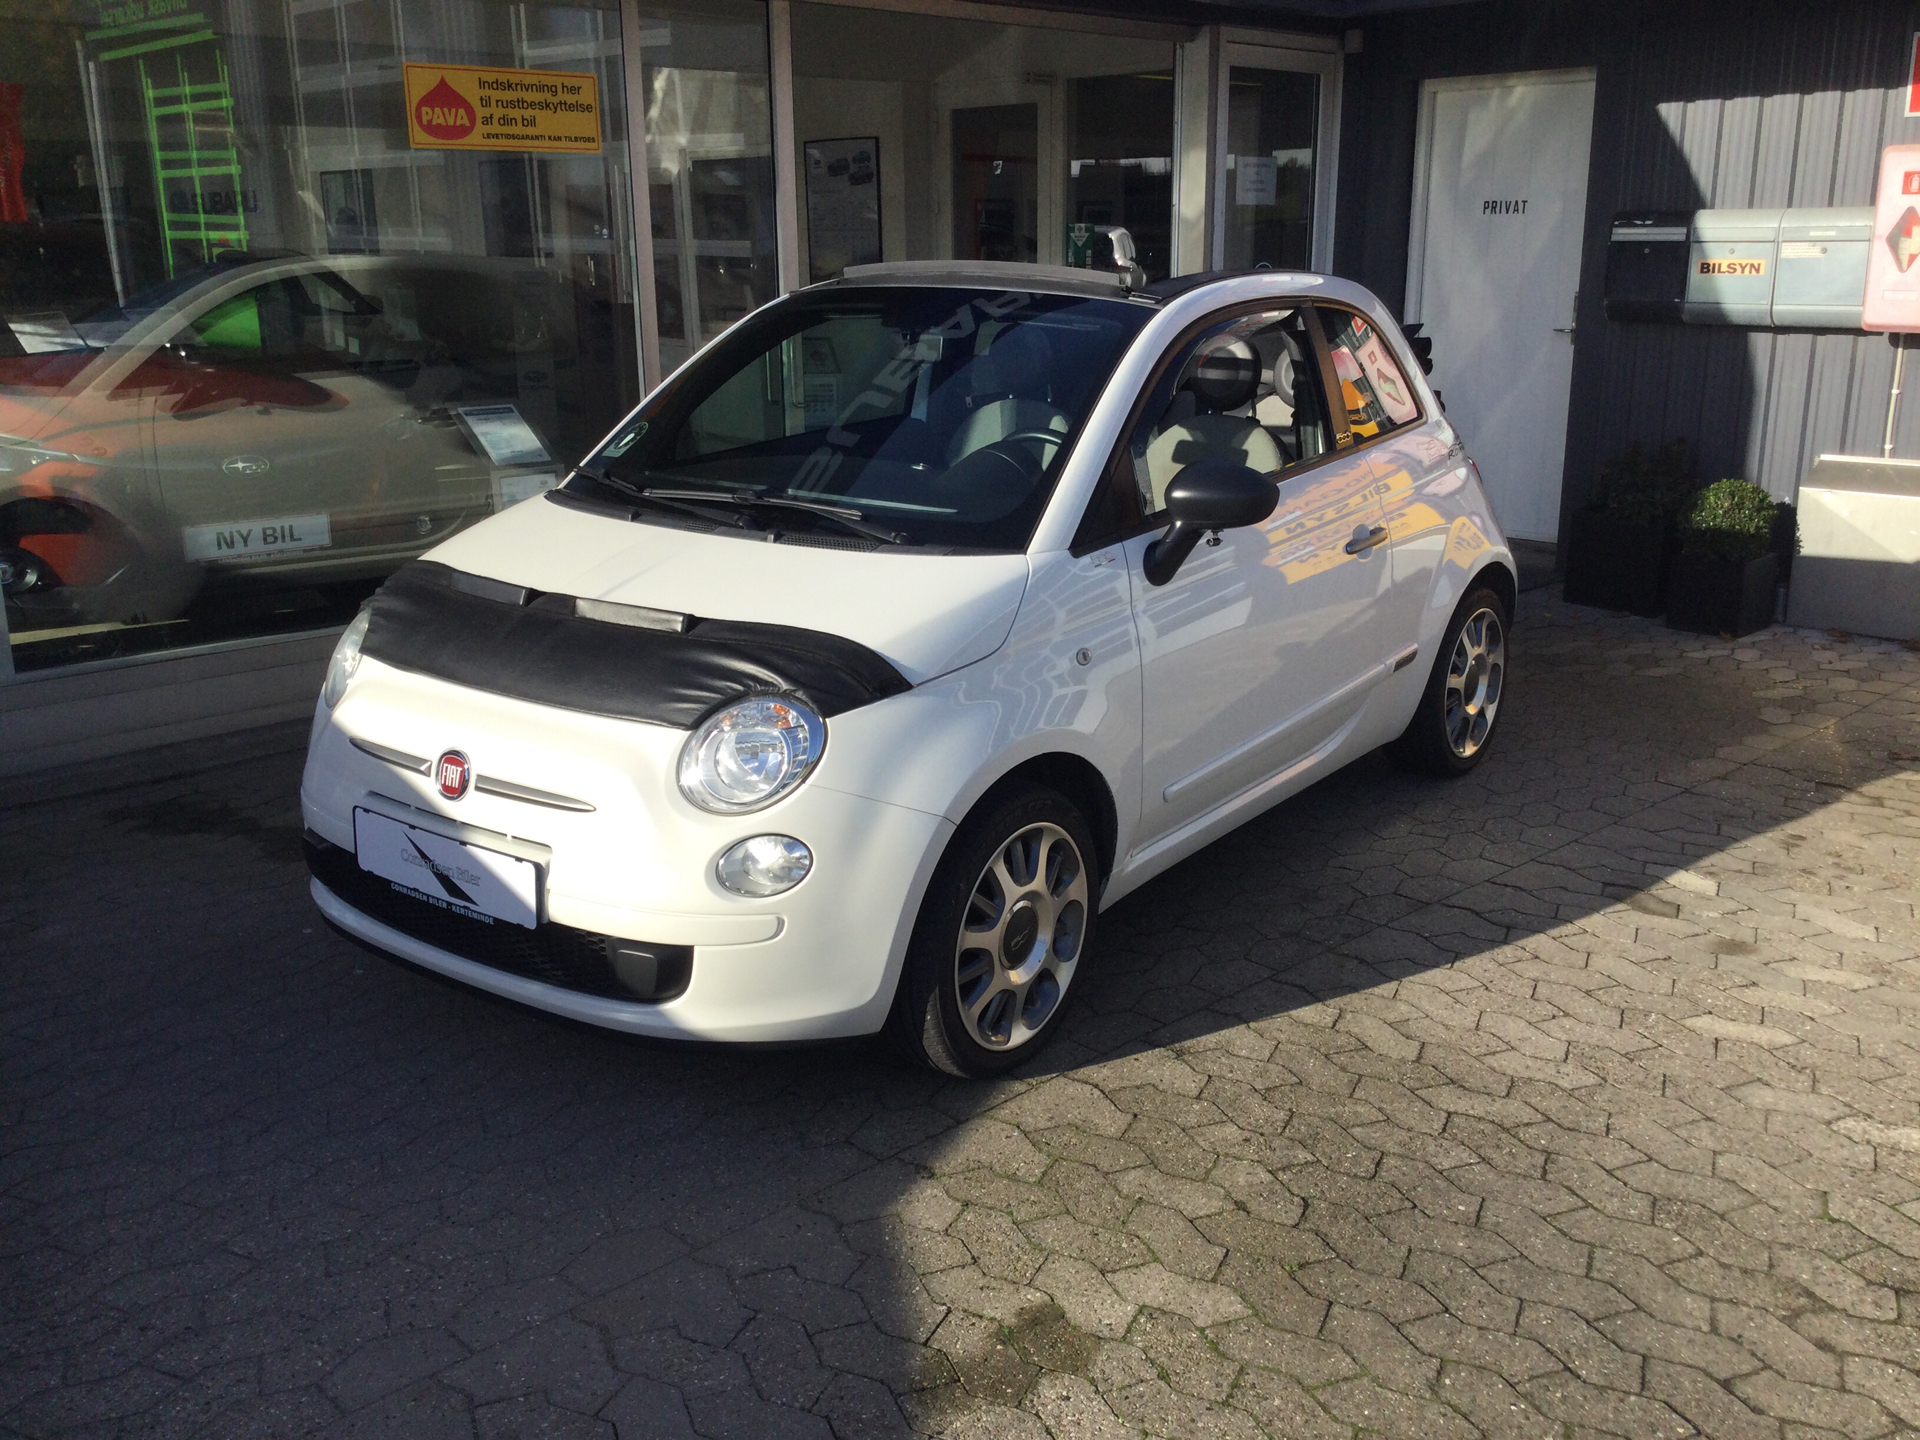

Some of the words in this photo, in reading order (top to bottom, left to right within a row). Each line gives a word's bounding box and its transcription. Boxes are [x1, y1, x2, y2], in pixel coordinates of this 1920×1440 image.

[478, 77, 558, 96] Indskrivning
[561, 82, 582, 95] her
[479, 95, 491, 108] til
[495, 97, 593, 114] rustbeskyttelse
[421, 106, 471, 127] PAVA
[481, 114, 494, 126] af
[497, 114, 517, 127] din
[521, 115, 536, 128] bil
[482, 133, 546, 141] LEVETIDSGARANTI
[1482, 200, 1528, 215] PRIVAT
[1700, 262, 1761, 275] BILSYN
[216, 529, 253, 550] NY
[262, 524, 302, 545] BIL
[441, 763, 463, 788] FIAT
[401, 848, 455, 878] Conradsen
[455, 866, 481, 887] Biler
[391, 882, 428, 902] CONRADSEN
[428, 896, 447, 909] BILER
[451, 905, 495, 925] KERTEMINDE
